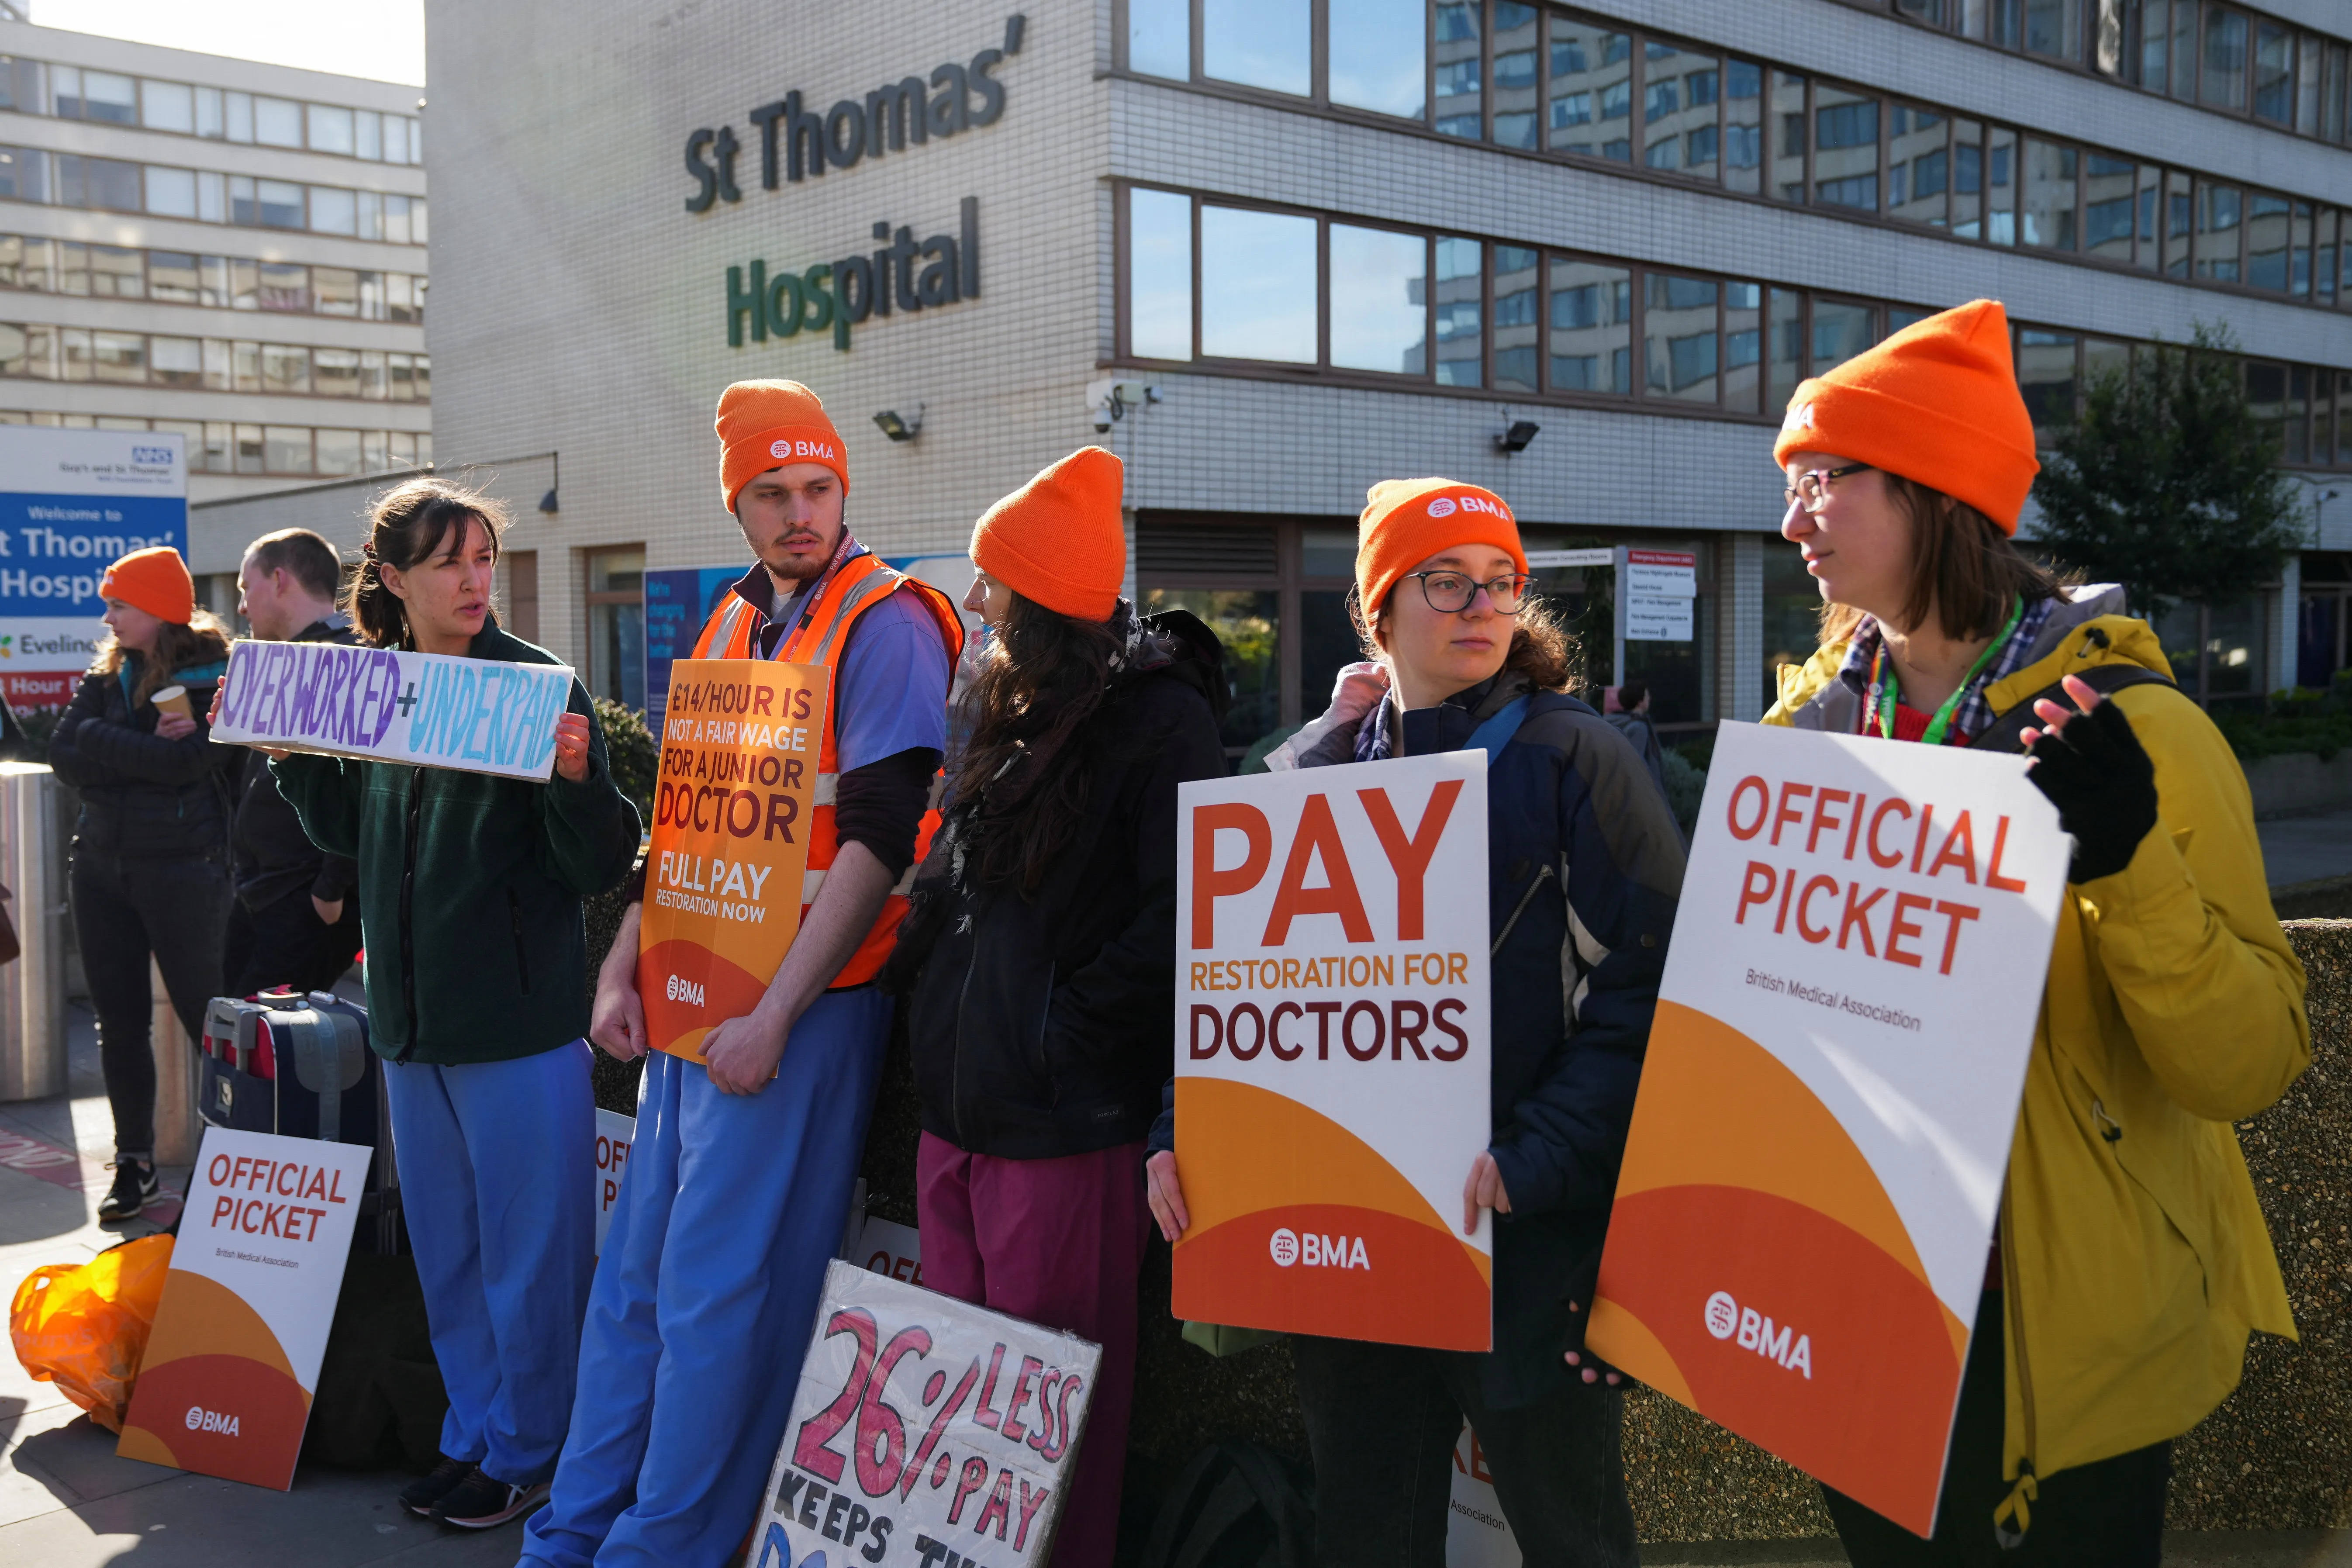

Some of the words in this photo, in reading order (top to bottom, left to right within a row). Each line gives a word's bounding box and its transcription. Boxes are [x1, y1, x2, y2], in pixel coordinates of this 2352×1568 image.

[685, 126, 742, 214] St
[749, 14, 1026, 190] Thomas'
[726, 195, 979, 351] Hospital
[1782, 403, 1813, 430] MA
[795, 441, 836, 461] BMA
[27, 506, 102, 522] Welcome
[104, 509, 123, 522] to
[1460, 497, 1510, 522] BMA
[0, 529, 12, 557] t
[830, 559, 839, 570] PAY
[836, 533, 853, 560] RESTORATIO
[1, 568, 103, 606] Hospi
[818, 581, 828, 595] BMA
[11, 677, 65, 694] Hour
[673, 680, 774, 716] £14/HOUR
[782, 688, 812, 720] IS
[667, 718, 691, 741] NOT
[693, 720, 703, 743] A
[705, 720, 736, 744] FAIR
[739, 722, 808, 752] WAGE
[664, 748, 694, 777] FOR
[695, 750, 707, 778] A
[708, 752, 804, 789] JUNIOR
[657, 782, 798, 844] DOCTOR
[1727, 775, 2027, 894] OFFICIAL
[658, 850, 705, 892] FULL
[710, 859, 772, 900] PAY
[1191, 779, 1465, 950] PAY
[656, 888, 718, 917] RESTORATION
[722, 902, 766, 924] NOW
[1735, 860, 1980, 976] PICKET
[1191, 955, 1394, 991] RESTORATION
[1404, 952, 1468, 986] FOR
[678, 978, 705, 1007] BMA
[1745, 968, 1785, 994] British
[1787, 979, 1838, 1008] Medical
[1839, 995, 1921, 1032] Association
[1190, 998, 1468, 1061] DOCTORS
[208, 1154, 347, 1204] OFFICIAL
[211, 1195, 326, 1242] PICKET
[215, 1248, 235, 1259] British
[236, 1251, 261, 1262] Medical
[262, 1255, 299, 1269] Association
[1302, 1233, 1370, 1270] BMA
[15, 1325, 93, 1352] bury's
[1737, 1306, 1811, 1380] BMA
[202, 1411, 240, 1437] BMA
[791, 1306, 980, 1504] 26%
[973, 1341, 1084, 1463] LESS
[774, 1468, 894, 1563] KEEPS
[946, 1456, 1050, 1553] PAY
[1451, 1498, 1505, 1531] Association
